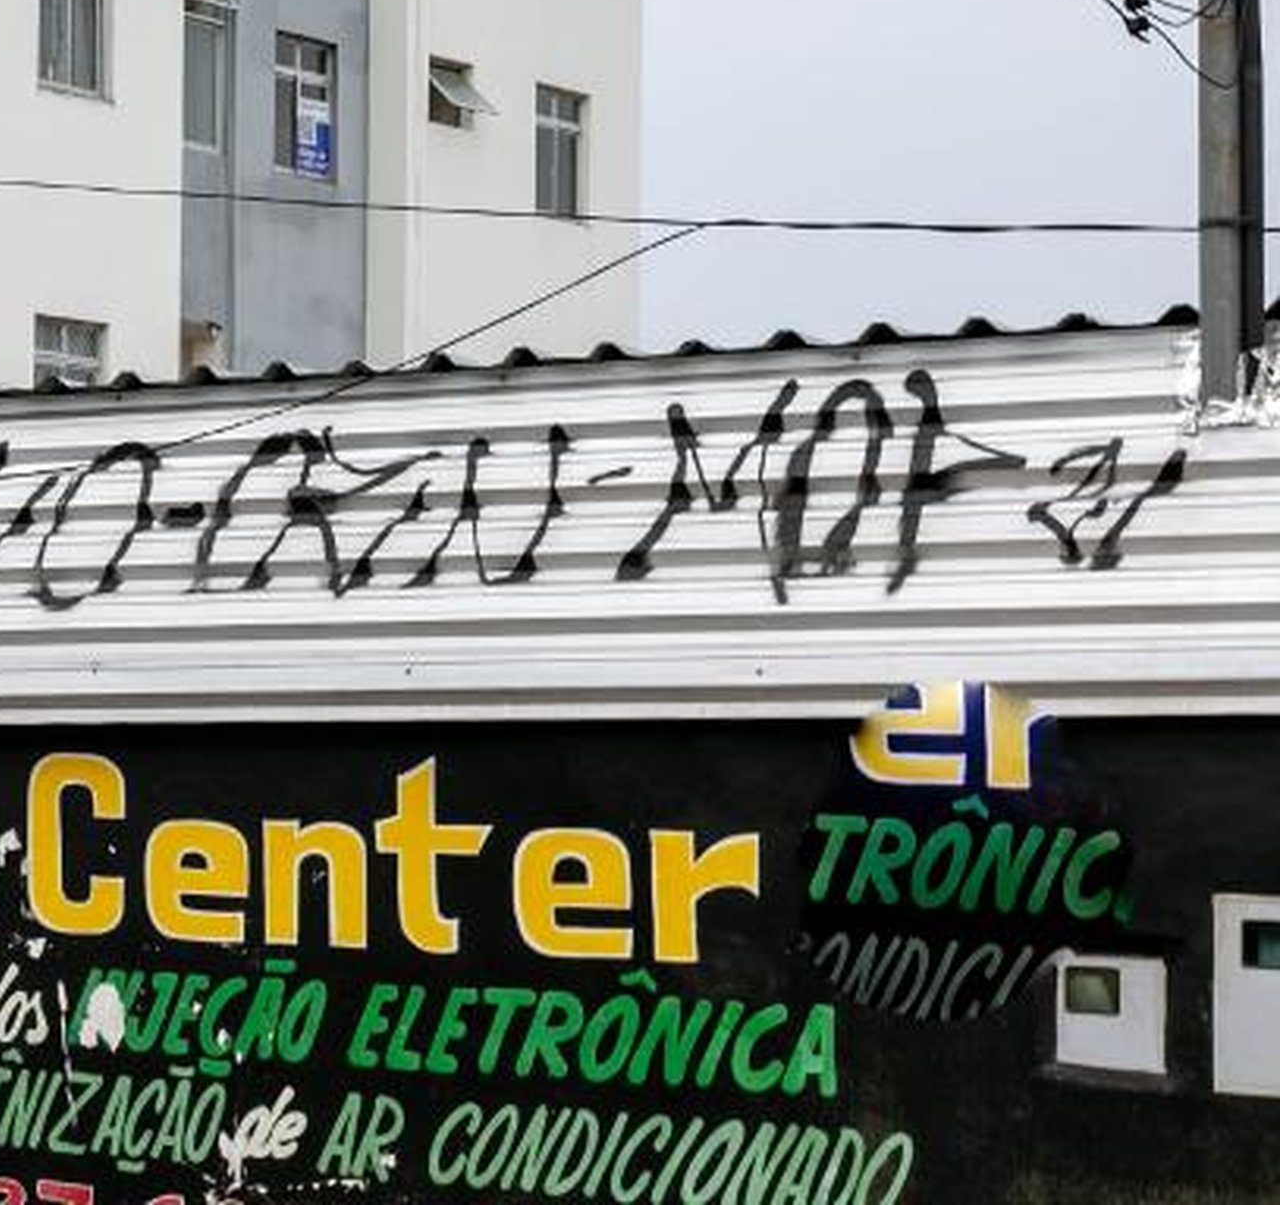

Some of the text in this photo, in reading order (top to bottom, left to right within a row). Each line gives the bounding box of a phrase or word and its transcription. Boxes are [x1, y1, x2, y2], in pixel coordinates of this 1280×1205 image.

[26, 751, 760, 964] Center
[808, 794, 1134, 923] TRÔNIC
[347, 967, 839, 1098] ELETRÔNICA
[226, 1085, 308, 1161] de
[316, 1092, 403, 1183] AR
[428, 1102, 915, 1205] CONDICIONADO
